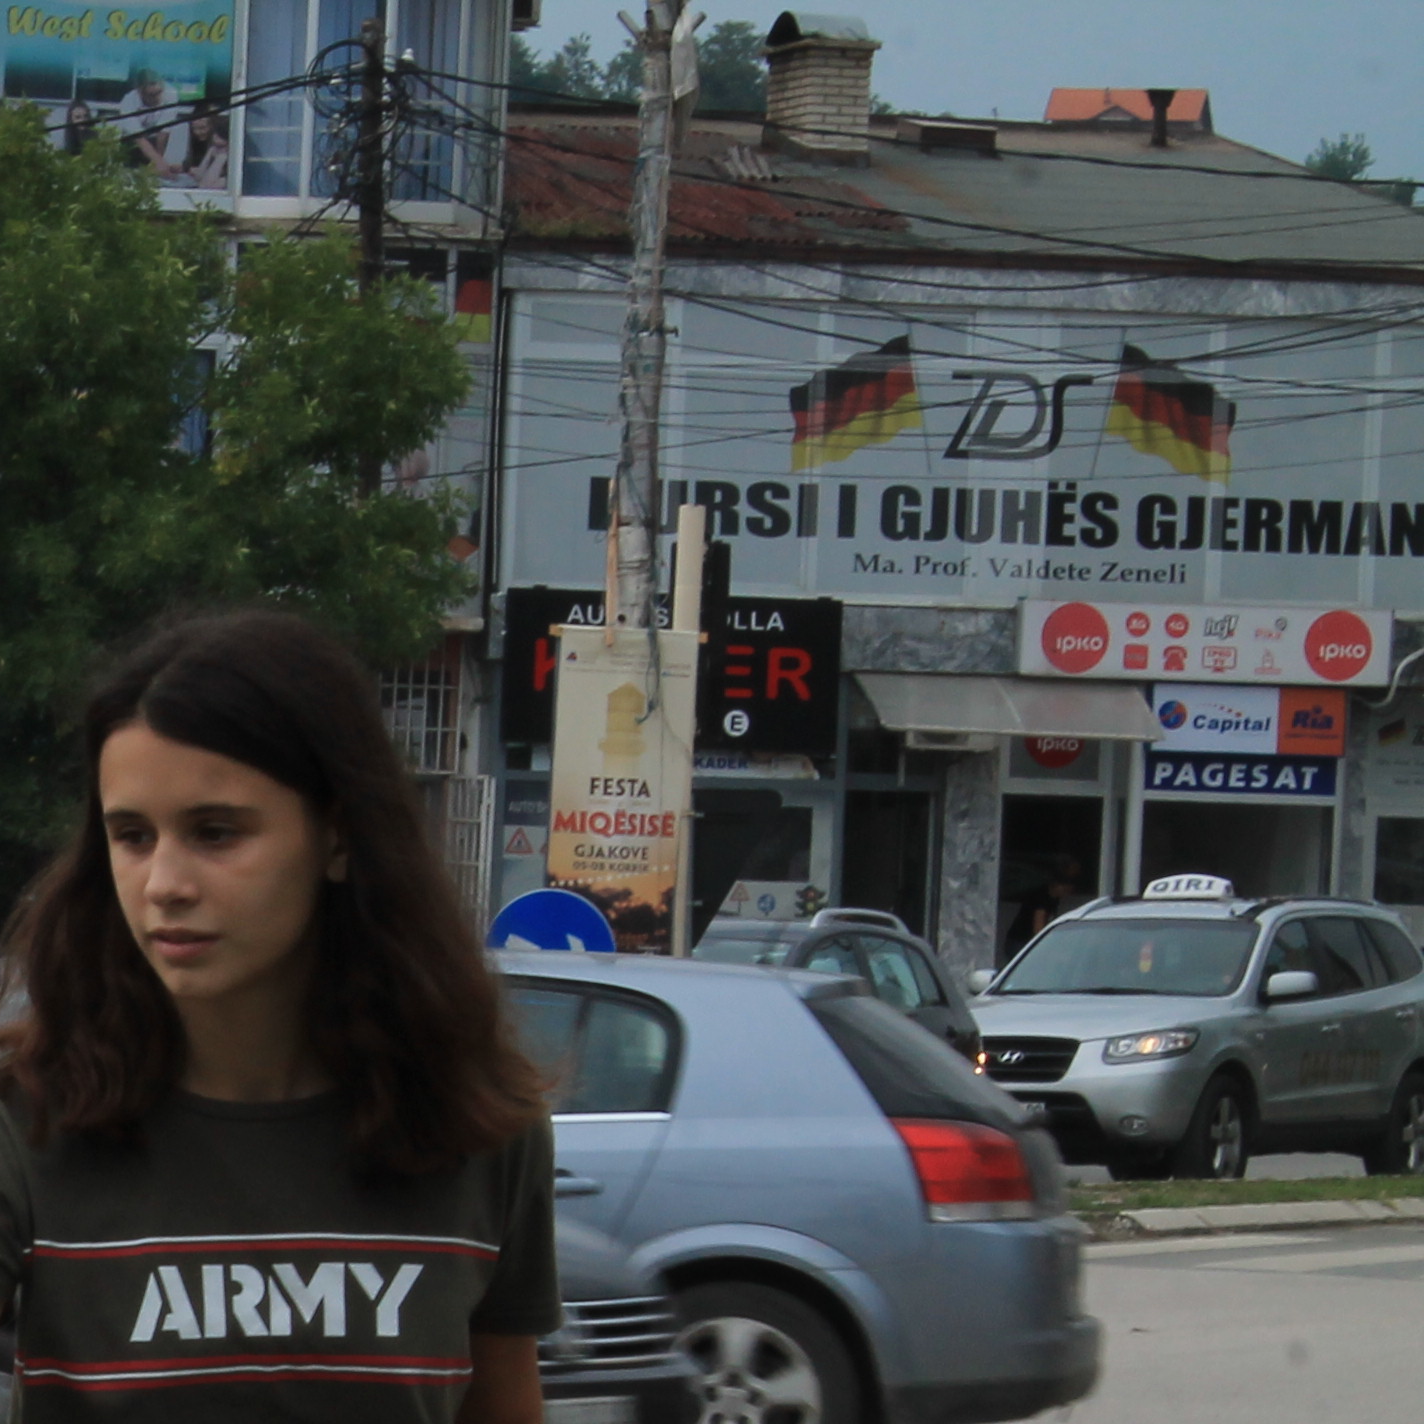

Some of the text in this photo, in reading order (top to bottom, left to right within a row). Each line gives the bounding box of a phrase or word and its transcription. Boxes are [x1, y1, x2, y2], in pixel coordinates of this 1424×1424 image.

[7, 5, 231, 45] West School
[837, 483, 858, 539] I
[880, 481, 1120, 549] GJUHËS
[852, 552, 1188, 586] Ma. Prof. Valdete Zeneli
[1192, 714, 1272, 735] Capital
[589, 776, 651, 798] FESTA
[1152, 761, 1319, 791] PAGESAT
[552, 809, 676, 839] MIQËSISË
[573, 844, 649, 861] GJAKOVE
[128, 1261, 424, 1343] ARMY
